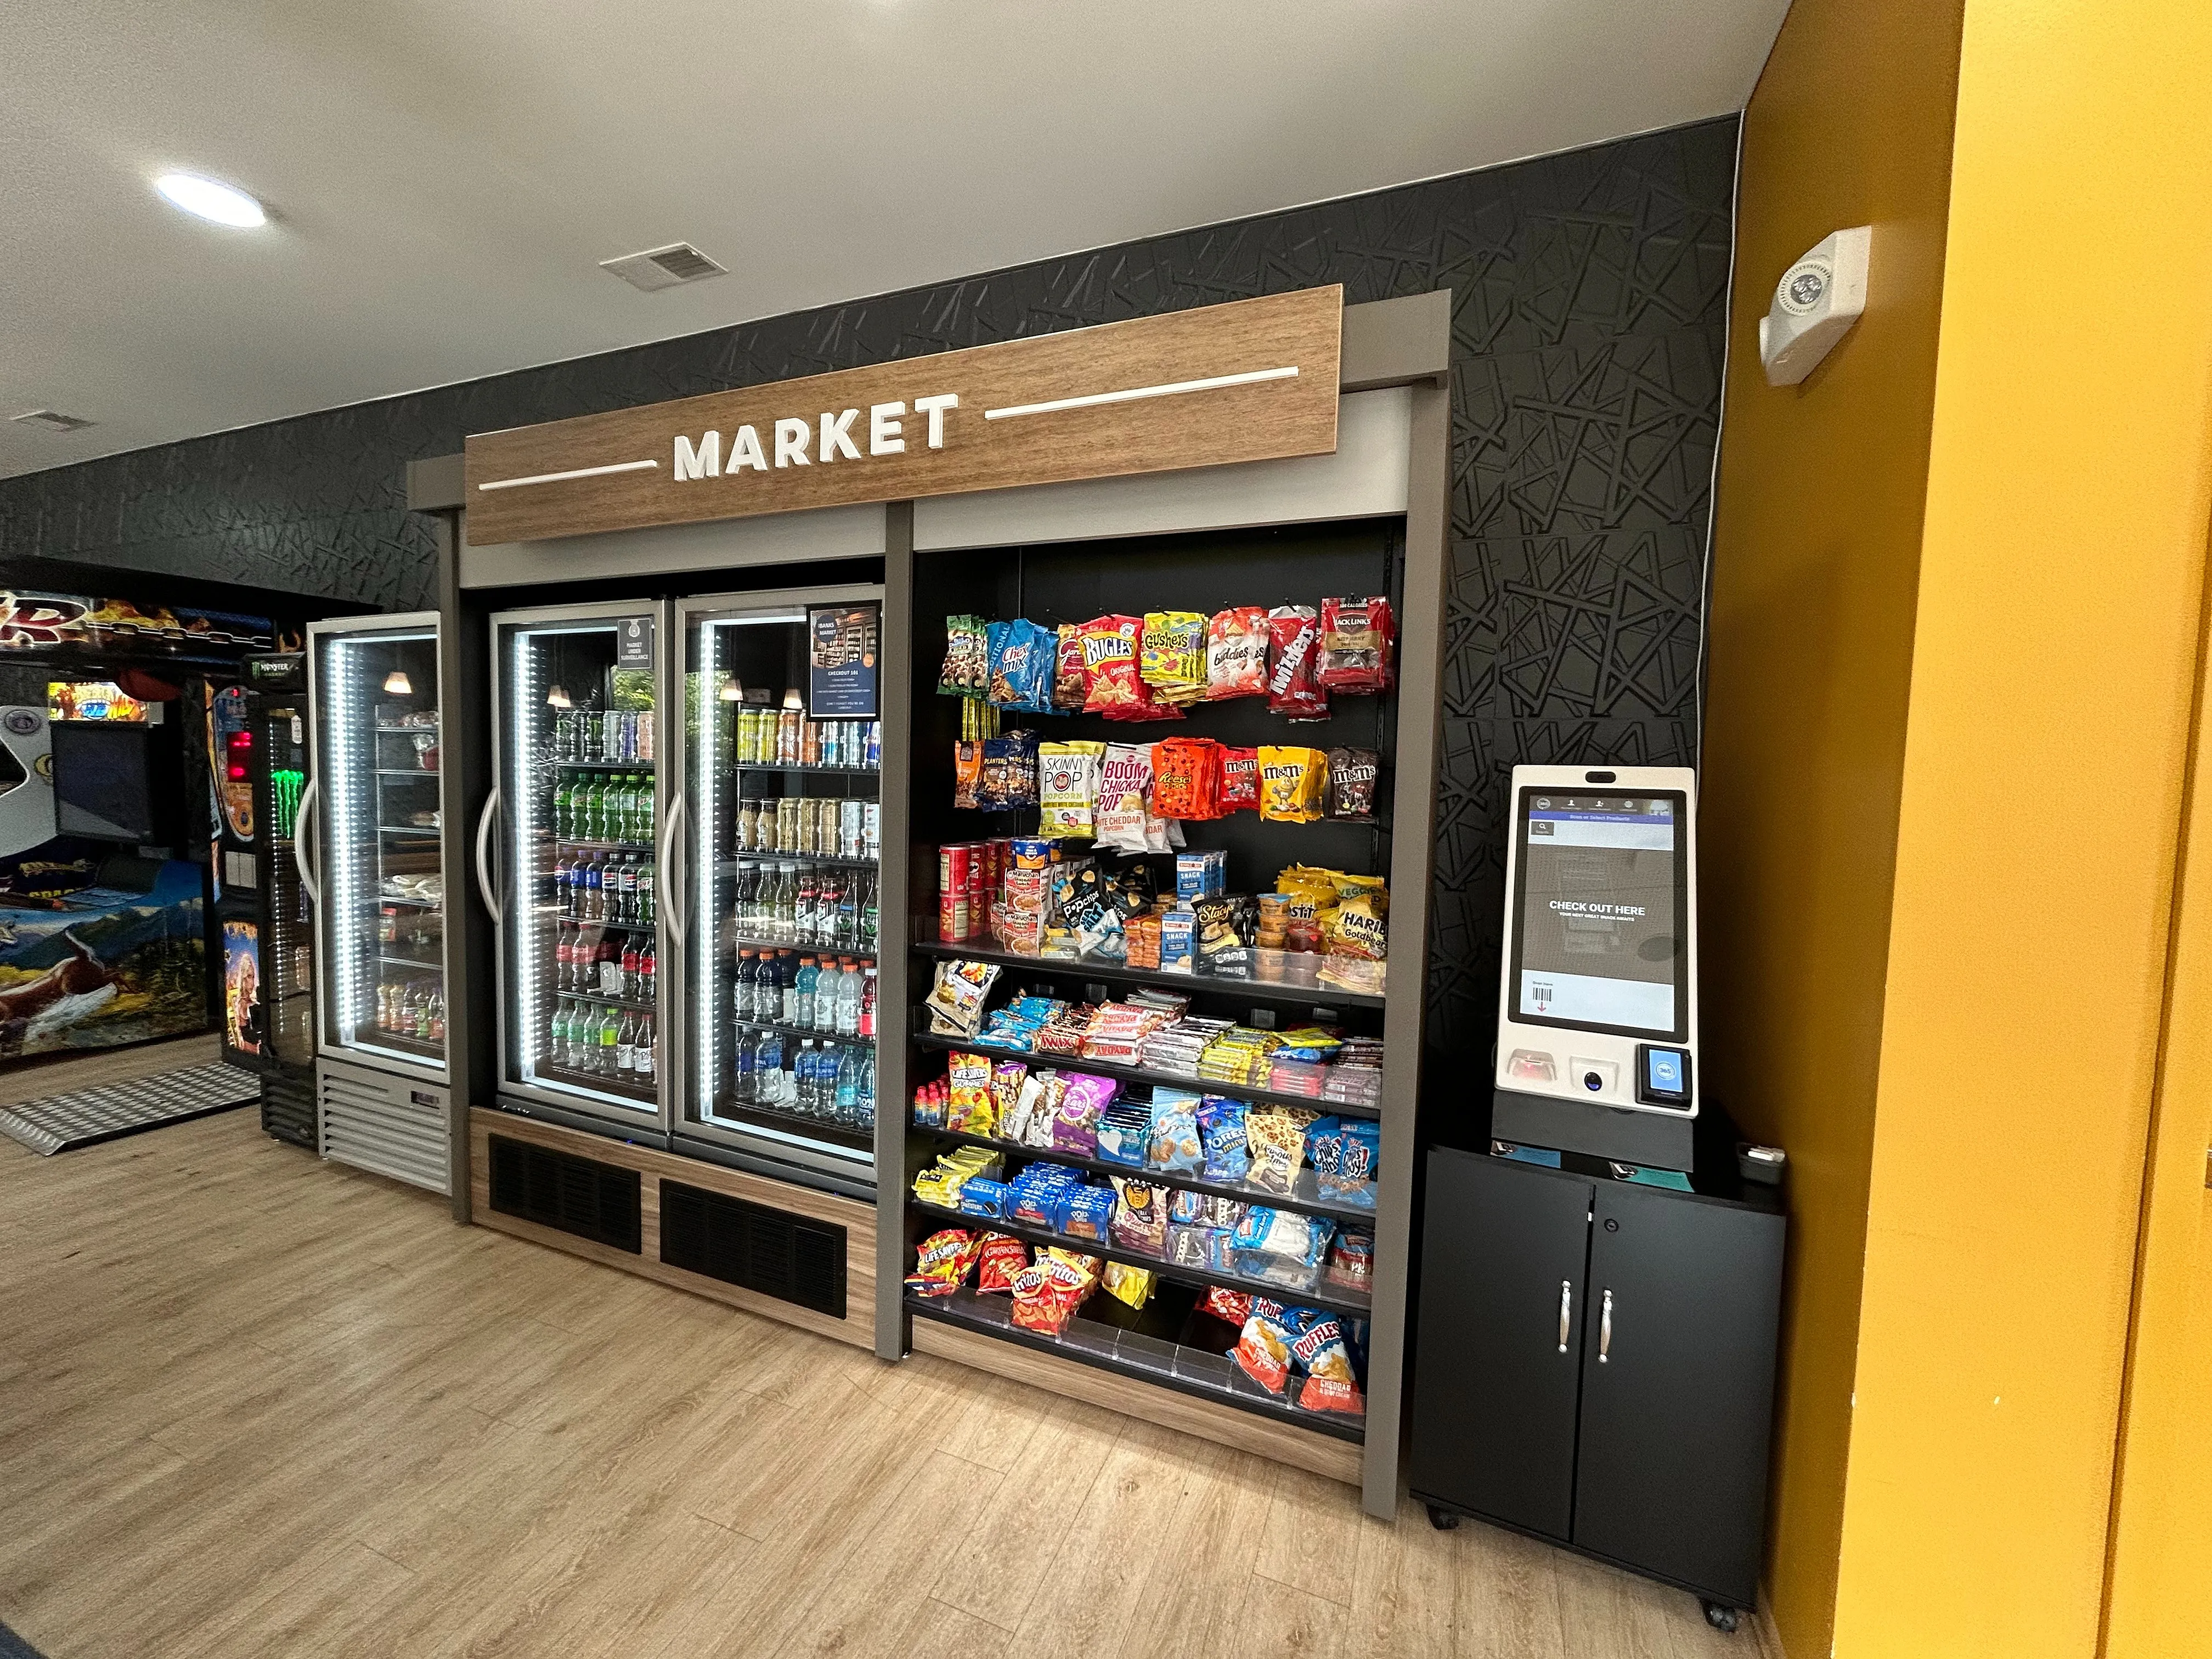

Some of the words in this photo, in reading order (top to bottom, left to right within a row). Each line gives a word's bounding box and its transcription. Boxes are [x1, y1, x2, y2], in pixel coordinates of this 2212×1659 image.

[674, 393, 959, 481] MARKET
[1003, 642, 1031, 662] Chex
[1082, 636, 1132, 667] BUGLES
[261, 663, 289, 671] MONSTER
[1003, 656, 1027, 674] mix
[1110, 665, 1136, 676] ORIGINAL
[1046, 757, 1083, 771] SKINNY
[1104, 761, 1148, 779] BOOM
[1045, 771, 1083, 792] POP
[1101, 780, 1141, 794] CHICKA
[1097, 793, 1124, 813] POP
[1109, 816, 1141, 825] CHEDDAR
[1064, 890, 1099, 918] popchips
[1199, 904, 1234, 923] Stacy's
[1549, 900, 1587, 911] CHECK
[1589, 904, 1613, 913] OUT
[1616, 905, 1645, 916] HERE
[1083, 909, 1105, 932] SALT
[1345, 929, 1388, 950] Goldbears
[1041, 1035, 1073, 1049] TWIX
[953, 1080, 985, 1088] GUMMIES
[1212, 1130, 1246, 1149] OREO
[1314, 1143, 1338, 1164] Chips
[1295, 1322, 1340, 1359] RUFFLES
[1255, 1347, 1280, 1369] CHEDDAR
[1320, 1379, 1351, 1391] CHEDDAR
